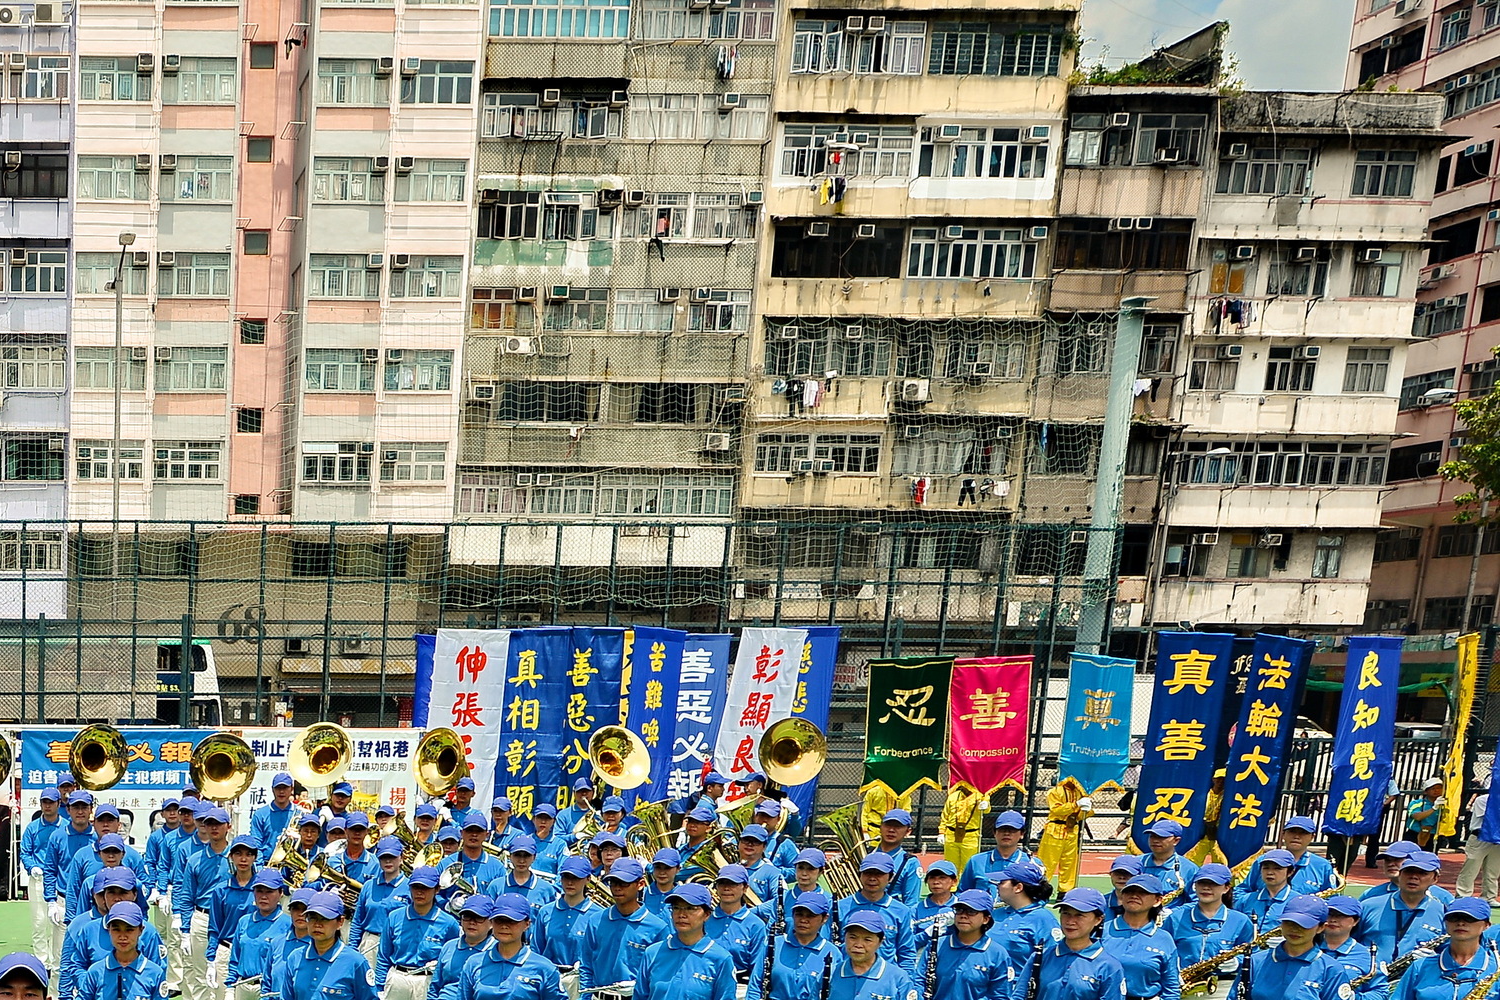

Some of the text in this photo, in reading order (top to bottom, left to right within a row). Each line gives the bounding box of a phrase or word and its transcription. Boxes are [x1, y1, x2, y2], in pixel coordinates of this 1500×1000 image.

[217, 603, 266, 644] 68
[878, 685, 937, 727] 忍
[959, 686, 1018, 730] 善
[46, 741, 193, 763] 善必報
[504, 649, 544, 821] 真相彰顯
[873, 745, 934, 759] Forbearance
[959, 745, 1019, 759] Compassion
[1142, 649, 1218, 828] 真善忍
[1229, 652, 1293, 832] 法輪大法
[1337, 650, 1381, 825] 良知覺醒
